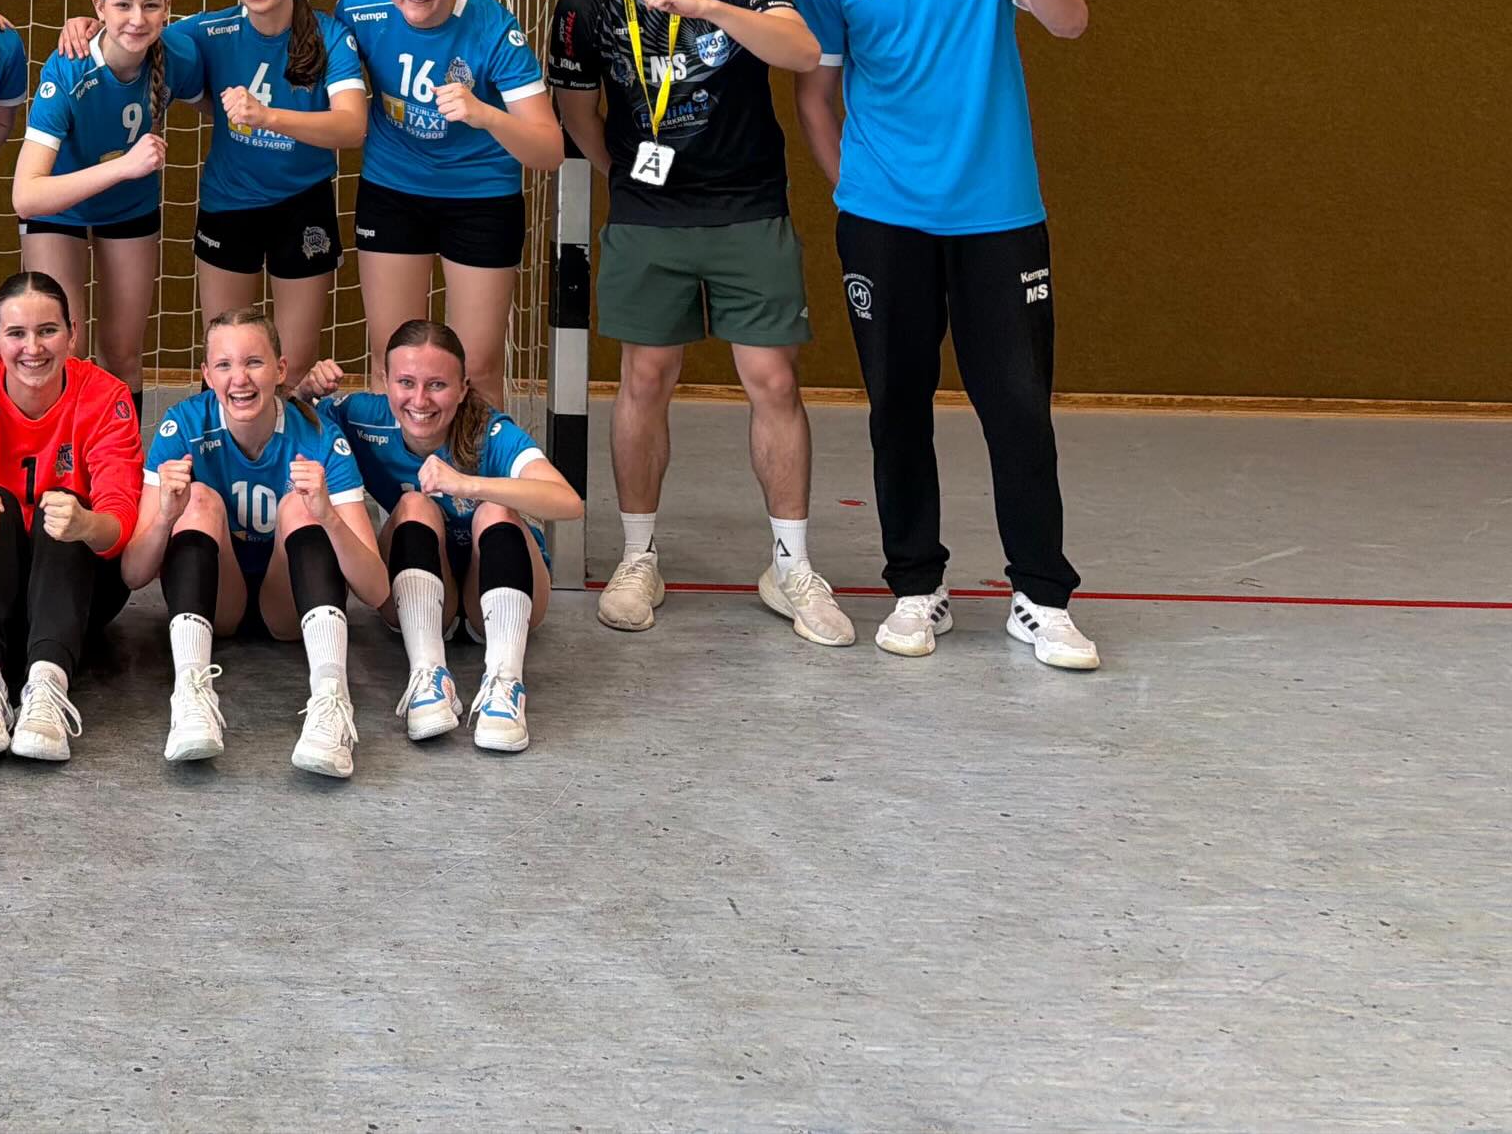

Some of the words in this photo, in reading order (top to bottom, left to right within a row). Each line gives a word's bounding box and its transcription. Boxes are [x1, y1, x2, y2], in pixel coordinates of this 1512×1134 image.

[352, 11, 388, 23] Kempa
[207, 24, 240, 36] Kempa
[248, 62, 272, 107] 4
[398, 53, 435, 103] 16
[122, 103, 143, 144] 9
[407, 111, 446, 131] TAXI
[252, 138, 293, 151] 6574909
[638, 152, 661, 178] A
[1020, 267, 1049, 284] Kempa
[1026, 283, 1049, 304] MS
[21, 456, 37, 505] 1
[232, 480, 277, 534] 10
